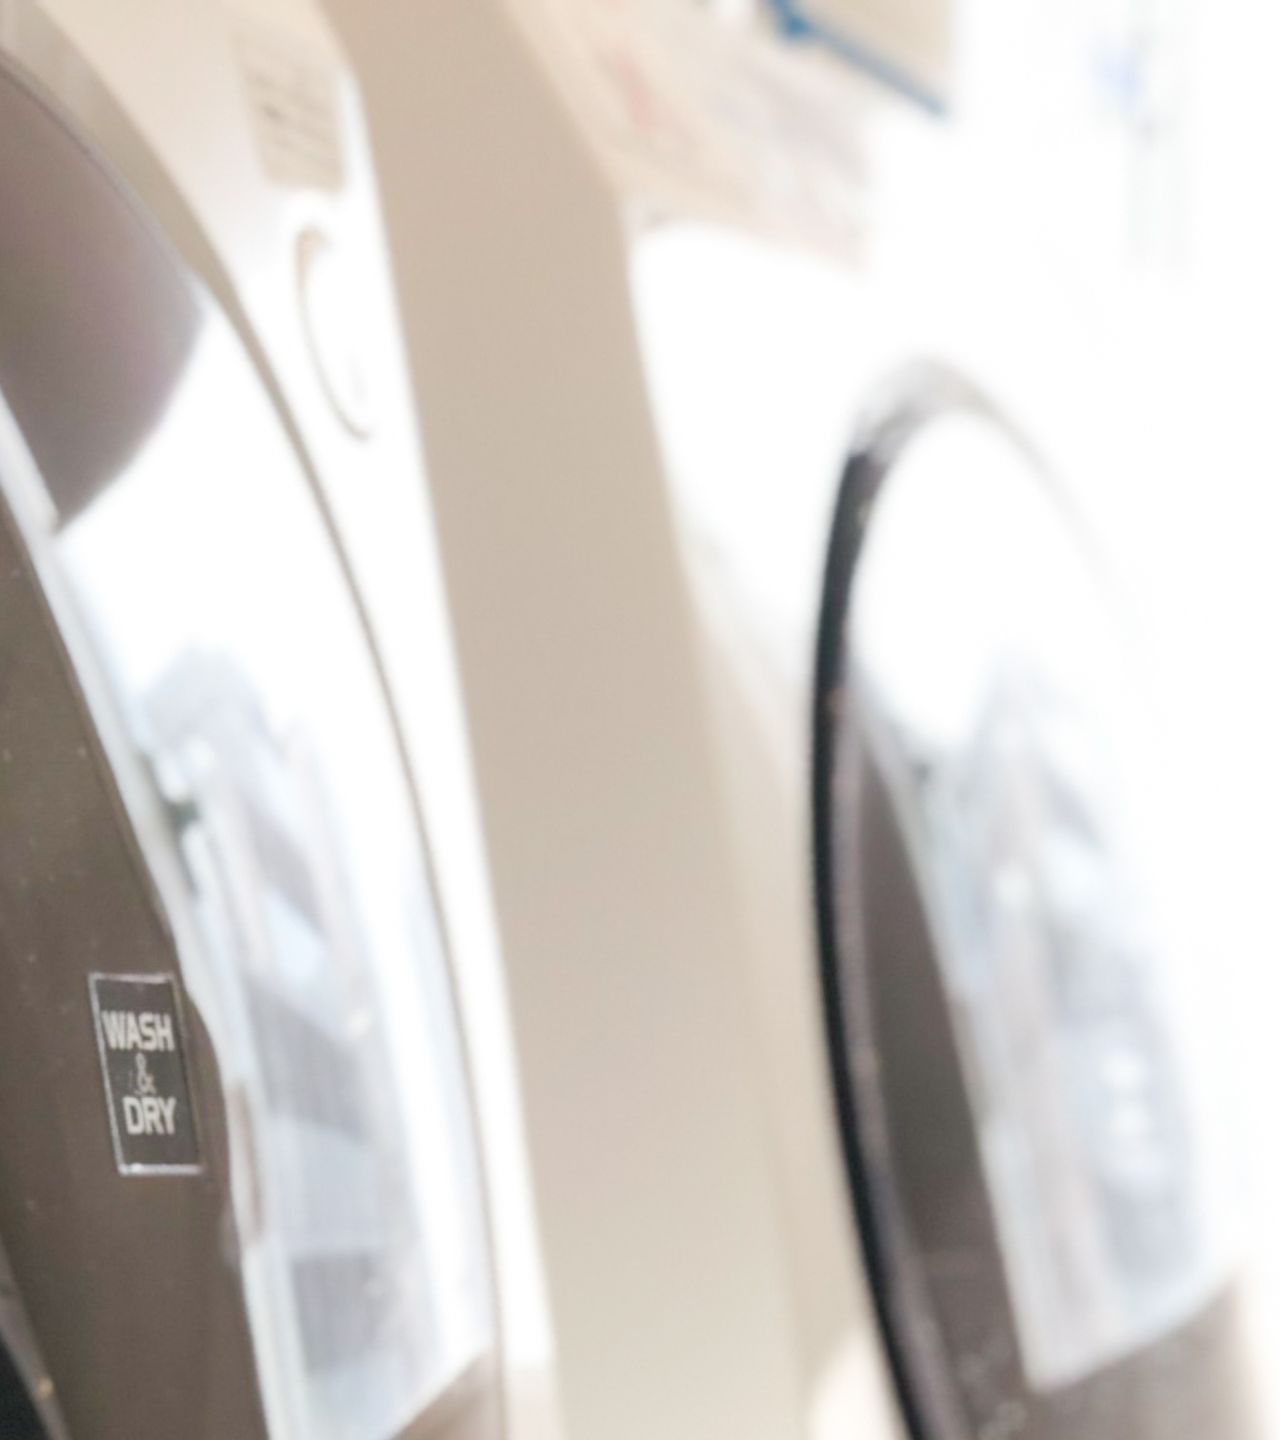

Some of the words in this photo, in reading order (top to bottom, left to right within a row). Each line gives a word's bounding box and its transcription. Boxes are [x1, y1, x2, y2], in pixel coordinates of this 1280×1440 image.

[100, 1010, 174, 1052] WASH
[134, 1051, 157, 1095] &
[122, 1096, 176, 1136] DRY
